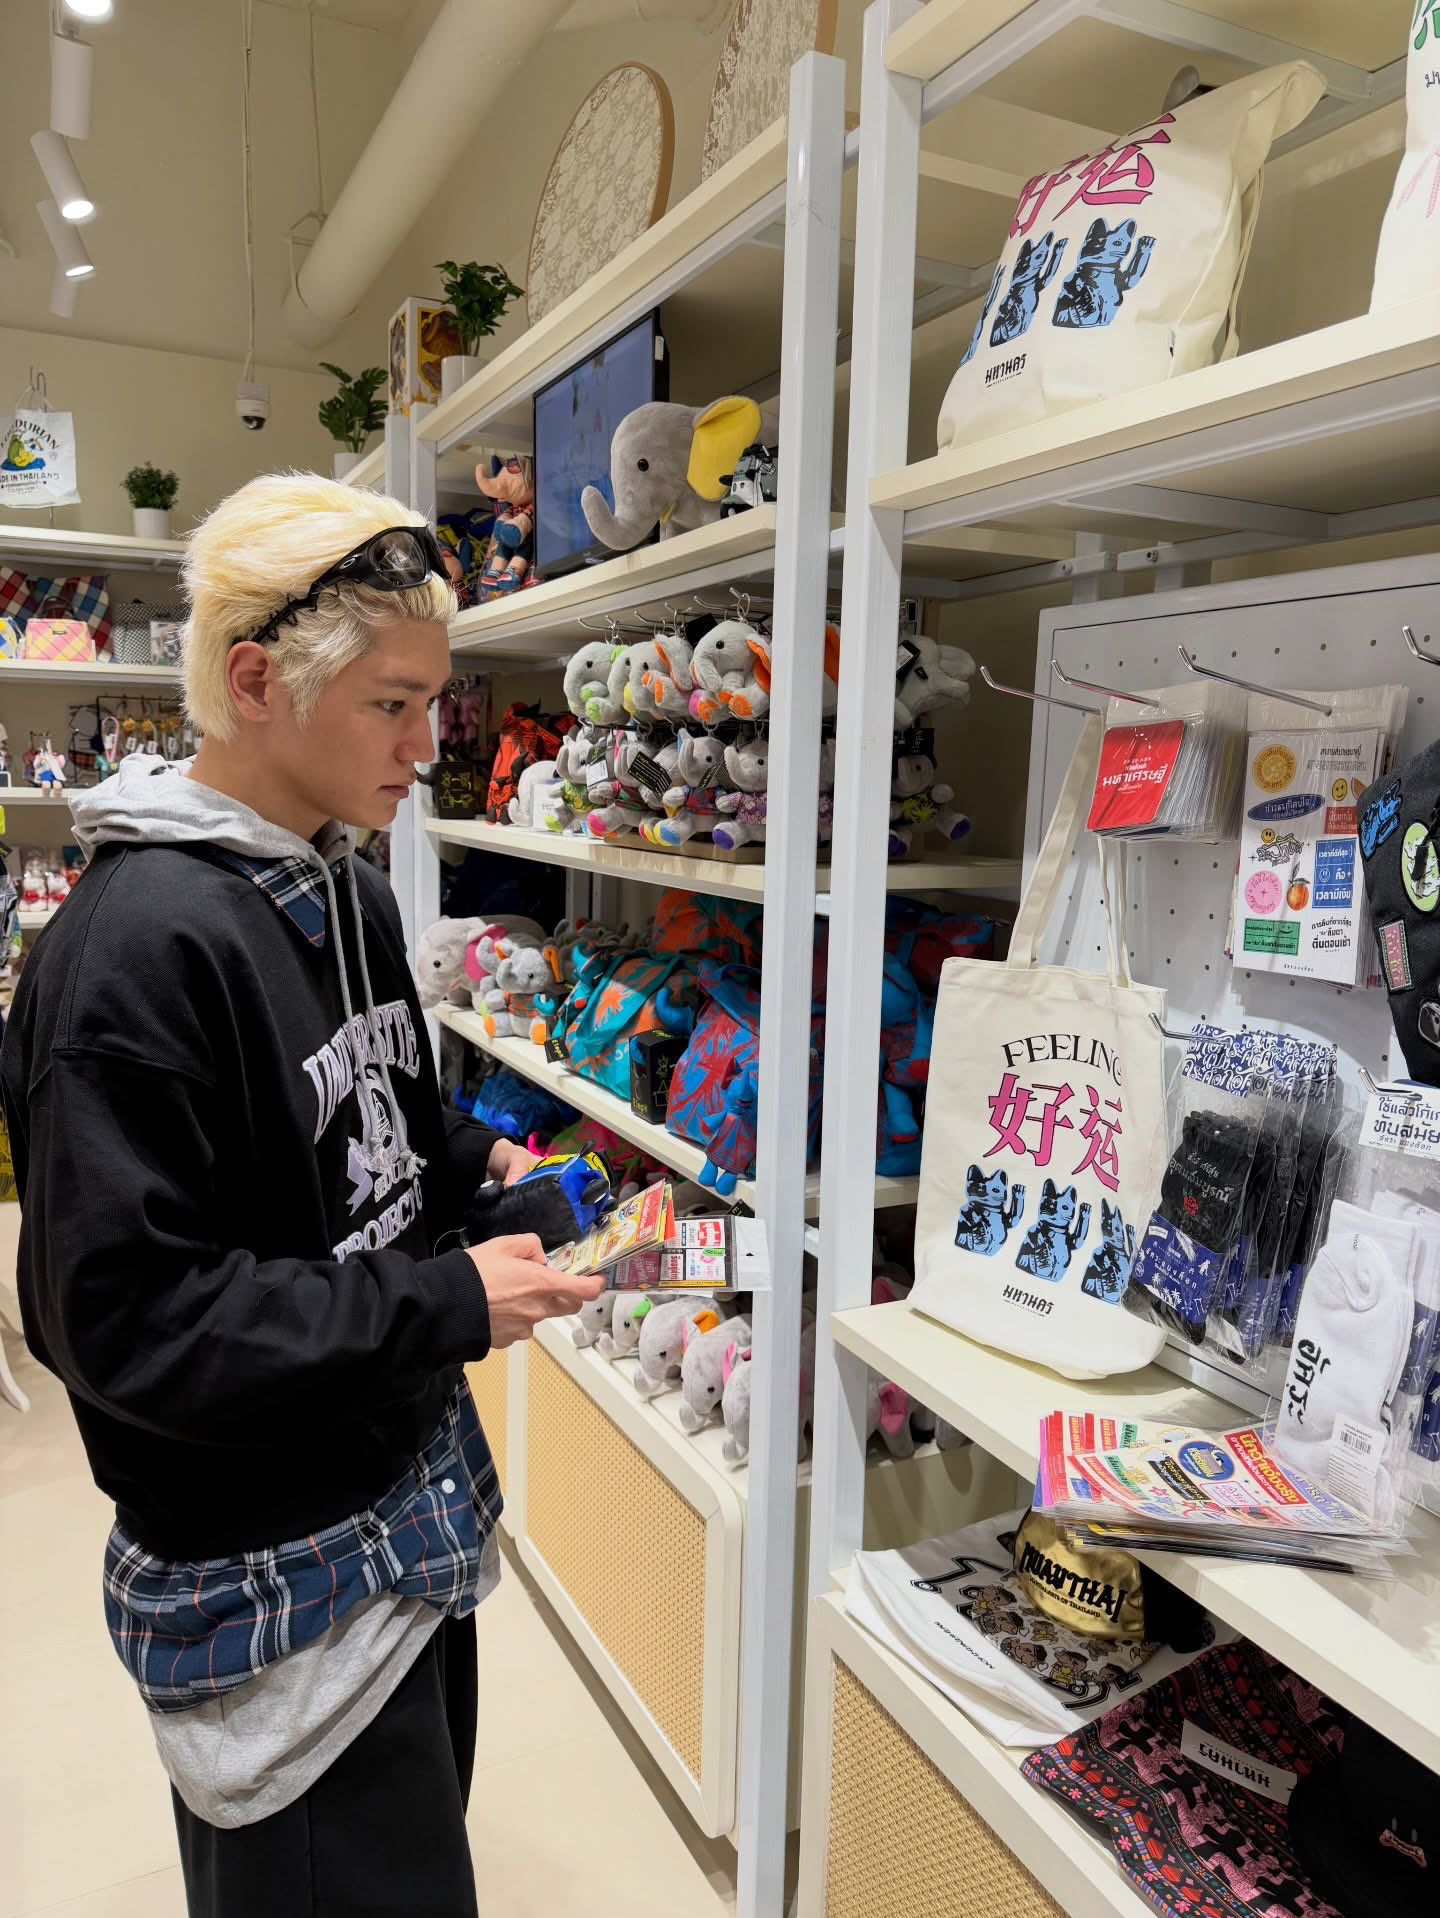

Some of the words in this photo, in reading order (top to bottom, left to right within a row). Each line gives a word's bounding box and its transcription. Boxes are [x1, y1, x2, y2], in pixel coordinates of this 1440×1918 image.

[985, 353, 1027, 384] มหานคร
[1102, 763, 1168, 788] มหาเศรษฐี
[1001, 1033, 1122, 1087] FEELING
[982, 1072, 1123, 1193] 好运
[1373, 1113, 1440, 1144] ทันสมัย
[1002, 1284, 1055, 1315] มหานคร
